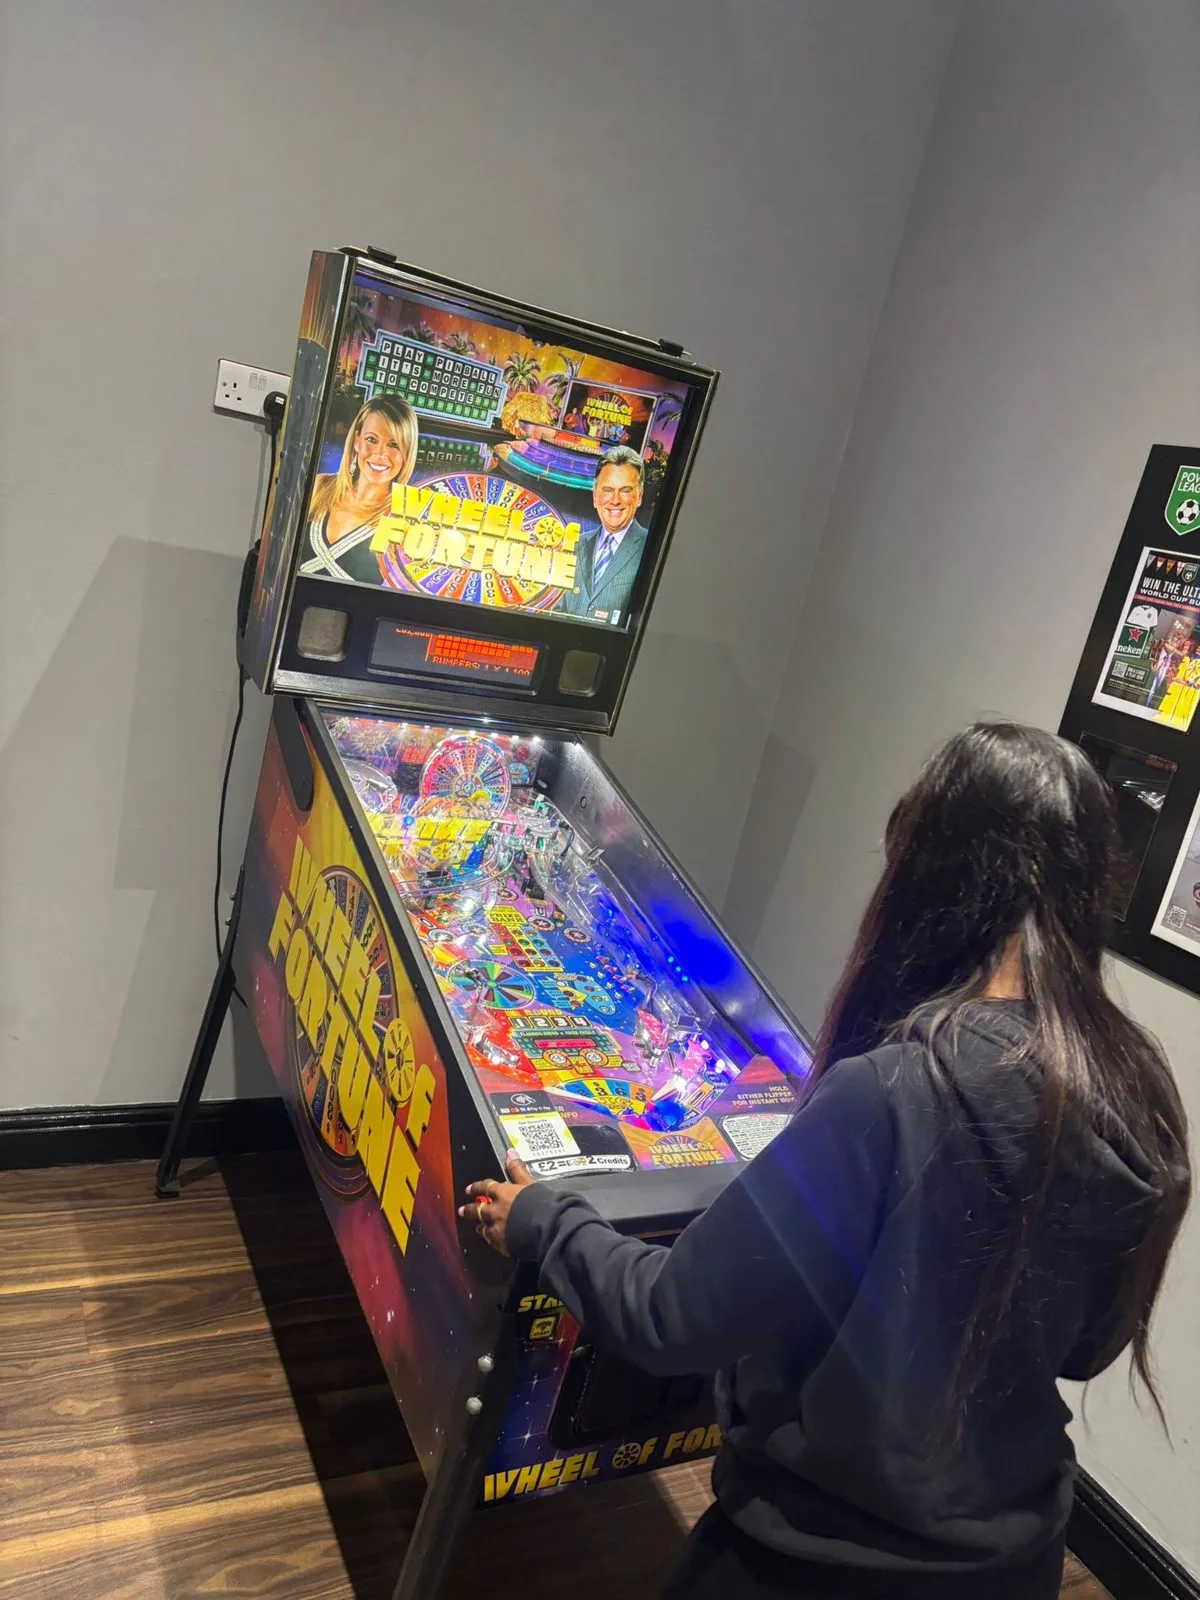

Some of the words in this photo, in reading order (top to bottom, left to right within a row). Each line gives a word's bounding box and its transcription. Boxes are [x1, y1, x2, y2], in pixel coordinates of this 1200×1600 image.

[383, 341, 424, 362] PLAY
[436, 357, 496, 383] PINBALL
[379, 356, 421, 376] IT'S
[433, 371, 468, 388] MORE
[477, 383, 500, 398] FUN
[377, 371, 397, 385] TO
[410, 378, 474, 404] COMPETE
[581, 405, 632, 426] FORTUNE
[587, 398, 620, 413] WHEEL
[390, 482, 531, 543] WHEEL
[369, 515, 577, 589] FORTUNE
[1142, 576, 1161, 591] WIN
[1163, 581, 1181, 595] THE
[1140, 588, 1169, 599] WORLD
[1170, 595, 1188, 604] CUP
[288, 834, 381, 1065] WHEEL
[533, 1018, 548, 1027] 2
[554, 1018, 568, 1027] 3
[574, 1017, 588, 1026] 4
[268, 890, 420, 1257] FORTUNE
[737, 1092, 764, 1100] EITHER
[764, 1091, 793, 1099] FLIPPER
[748, 1097, 779, 1106] INSTANT
[649, 1142, 698, 1154] WHEEL
[651, 1150, 725, 1166] FORTUNE
[586, 1154, 597, 1165] 2
[597, 1157, 629, 1165] Credits
[483, 1451, 600, 1503] WHEEL
